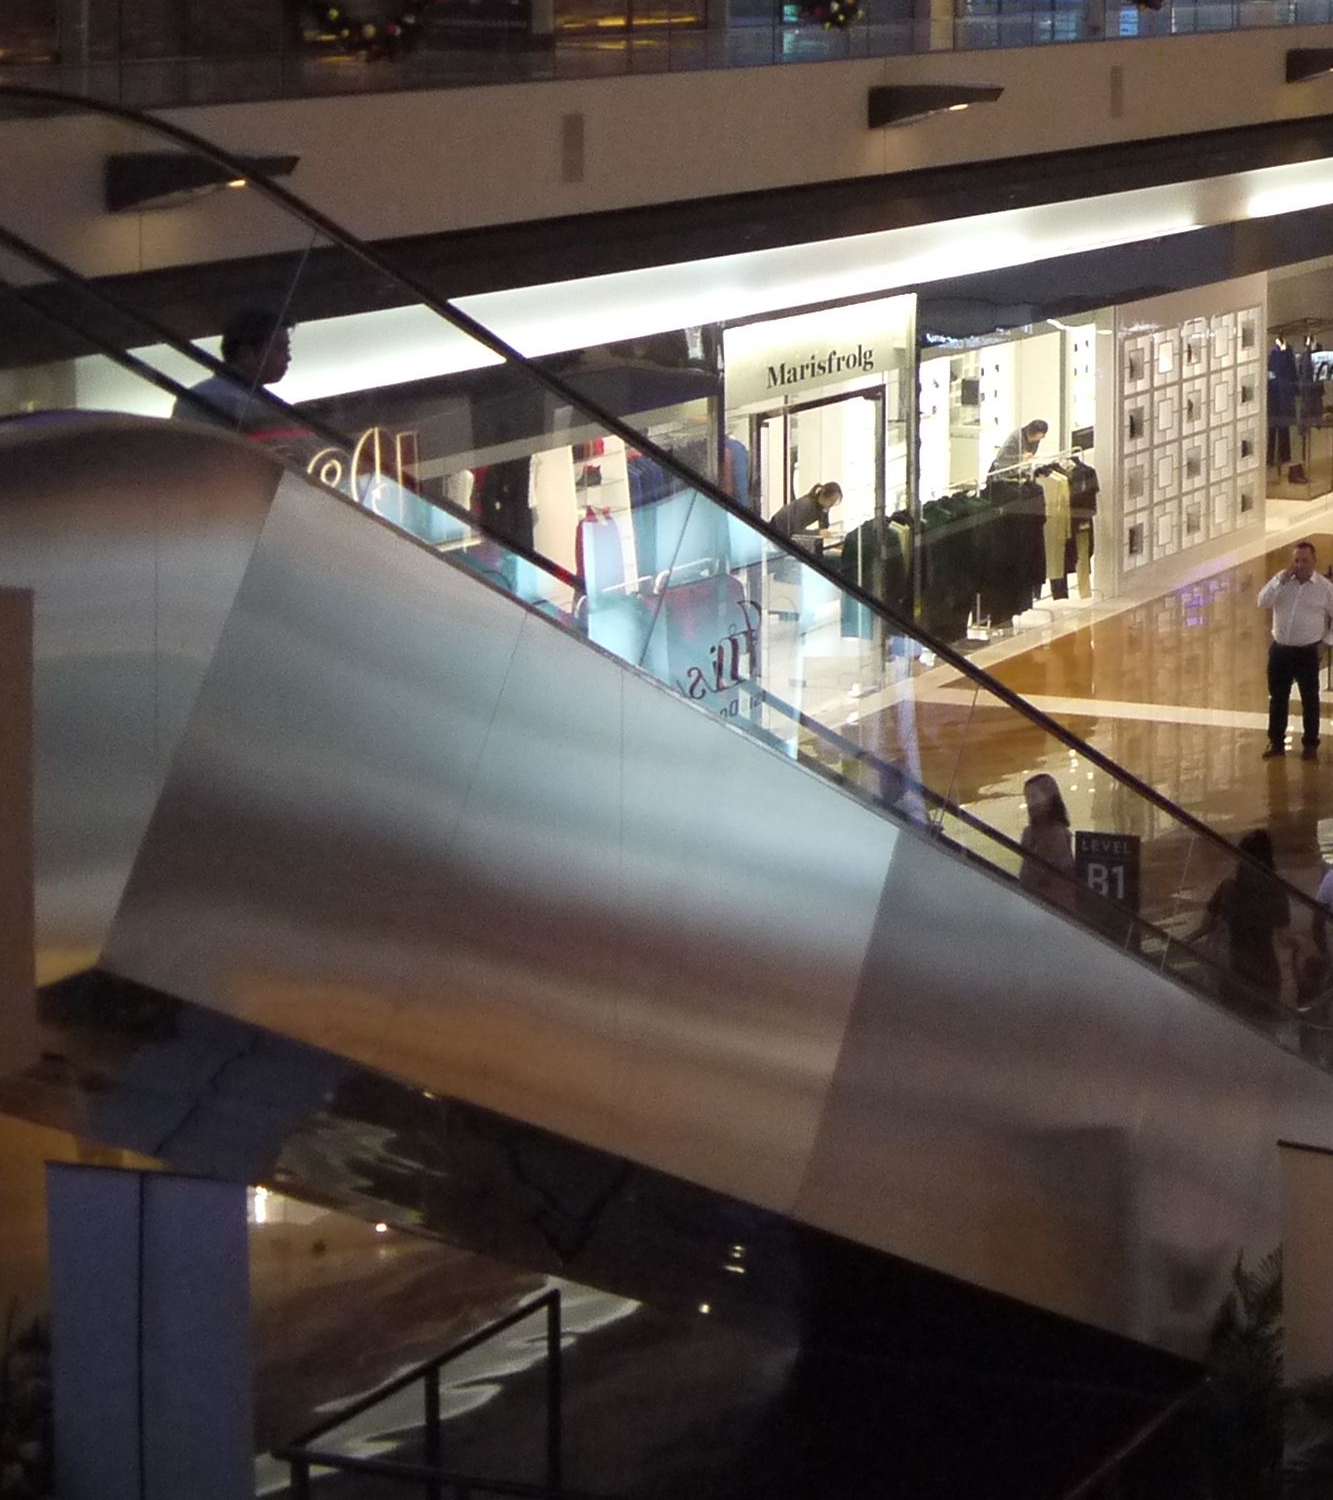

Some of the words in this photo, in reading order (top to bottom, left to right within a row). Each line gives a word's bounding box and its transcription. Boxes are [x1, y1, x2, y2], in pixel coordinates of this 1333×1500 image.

[766, 344, 875, 389] Marisfrolg
[1081, 838, 1132, 854] LEVEL
[1087, 862, 1125, 900] B1
